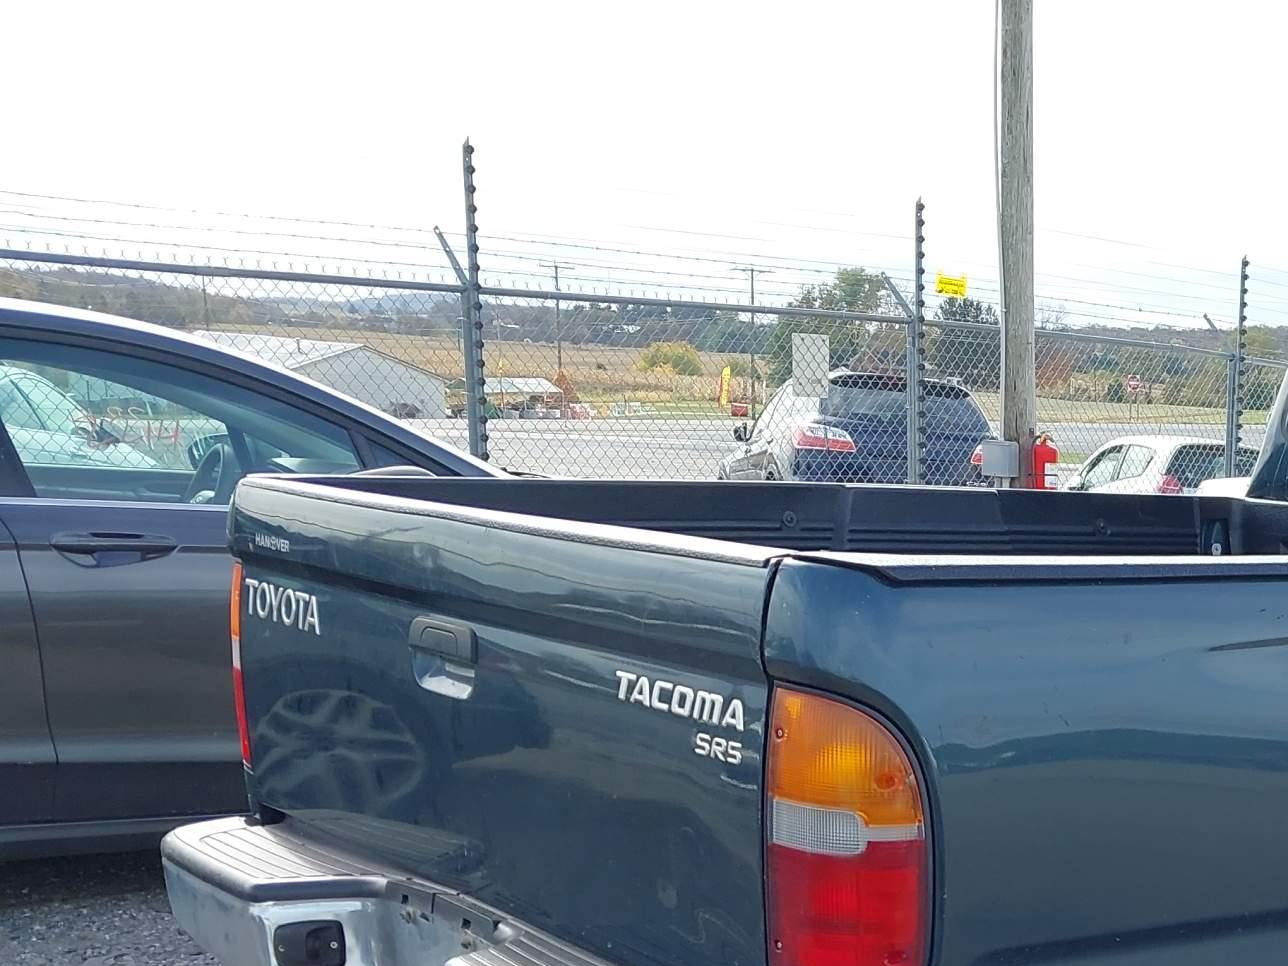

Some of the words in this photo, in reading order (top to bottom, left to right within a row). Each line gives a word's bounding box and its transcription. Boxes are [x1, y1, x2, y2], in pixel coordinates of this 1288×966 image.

[255, 532, 290, 553] HANOVER
[245, 578, 321, 636] TOYOTA
[615, 670, 745, 732] TACOMA
[694, 732, 743, 765] SR5
